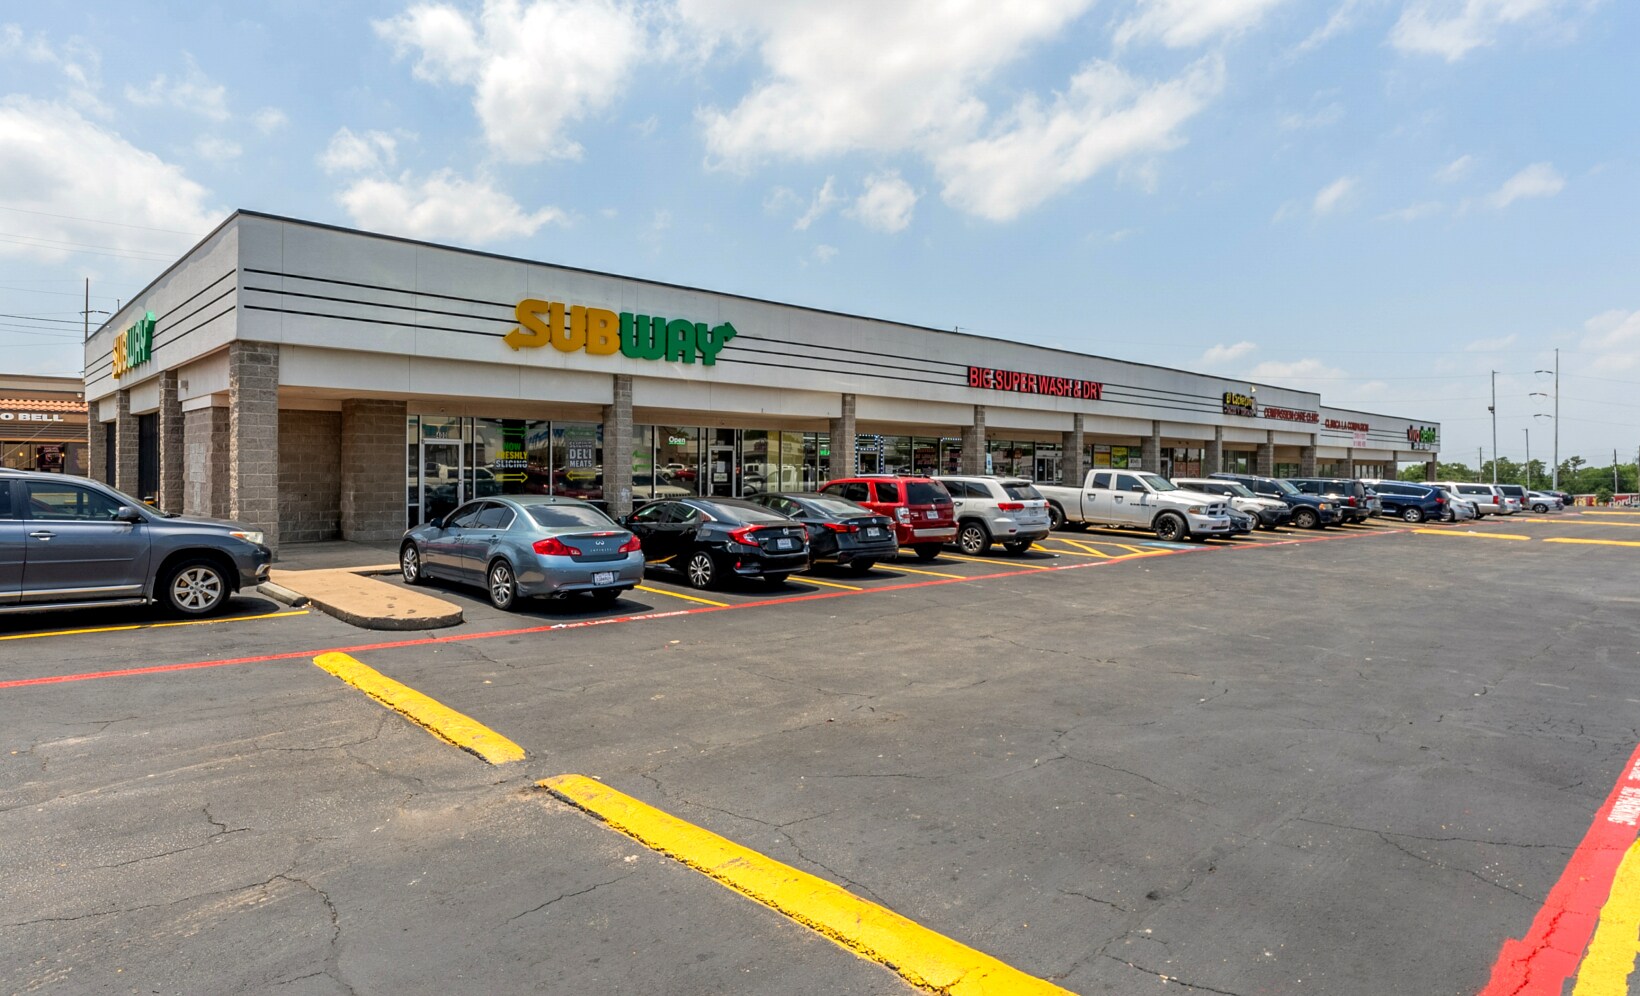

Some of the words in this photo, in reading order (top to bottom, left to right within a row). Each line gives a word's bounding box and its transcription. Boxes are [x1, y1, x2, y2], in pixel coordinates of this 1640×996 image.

[502, 298, 738, 366] SUBWAY
[112, 309, 156, 379] SUBWAY
[970, 367, 992, 389] BIG
[995, 370, 1036, 394] SUPER
[1038, 374, 1072, 397] WASH
[1073, 380, 1081, 398] &
[1083, 381, 1103, 400] DRY
[18, 413, 64, 422] BELL
[668, 436, 686, 444] Open
[503, 442, 522, 452] NOW
[495, 451, 528, 460] FRESHLY
[569, 449, 592, 460] DELI
[496, 460, 528, 469] SLICING
[569, 460, 592, 468] MEATS
